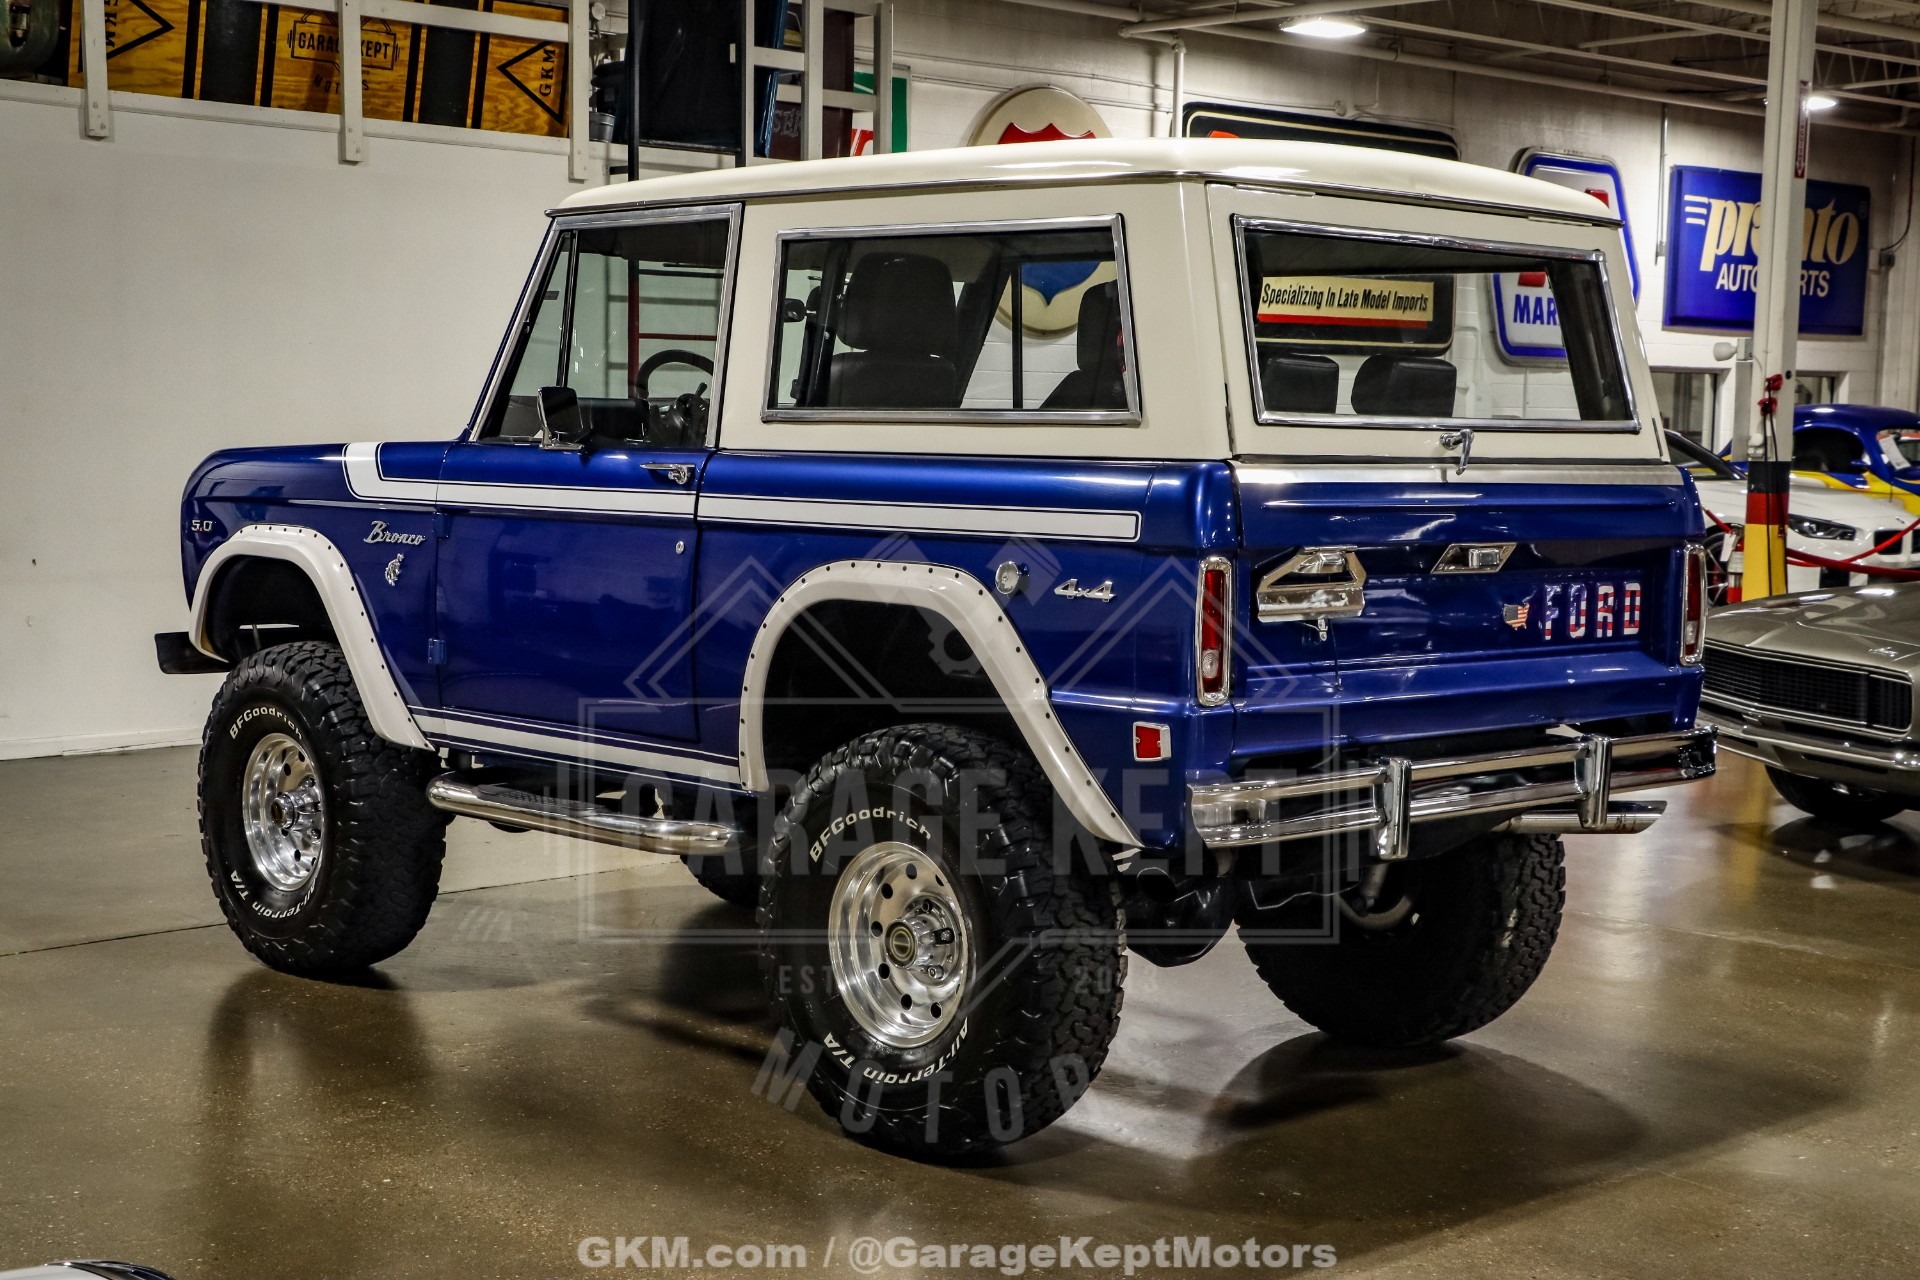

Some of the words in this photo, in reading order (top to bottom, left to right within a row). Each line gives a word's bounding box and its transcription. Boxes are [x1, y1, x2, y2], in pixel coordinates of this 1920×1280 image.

[298, 32, 340, 53] GARA
[312, 74, 369, 95] MOTS
[539, 48, 556, 96] GKM
[1262, 283, 1324, 309] Specializing
[1325, 287, 1335, 306] In
[1337, 288, 1359, 308] Late
[1360, 289, 1391, 309] Model
[1392, 291, 1428, 313] Imports
[1800, 270, 1830, 298] RTS
[1514, 294, 1557, 326] MAR
[191, 520, 212, 532] 5.0
[363, 520, 426, 545] Bronco
[1544, 582, 1641, 641] FORD
[229, 706, 303, 740] BFGoodrich
[809, 806, 932, 863] BFGoodrich
[229, 869, 250, 901] T/A
[823, 1032, 856, 1070] T/A
[862, 1016, 969, 1085] All-Terrain
